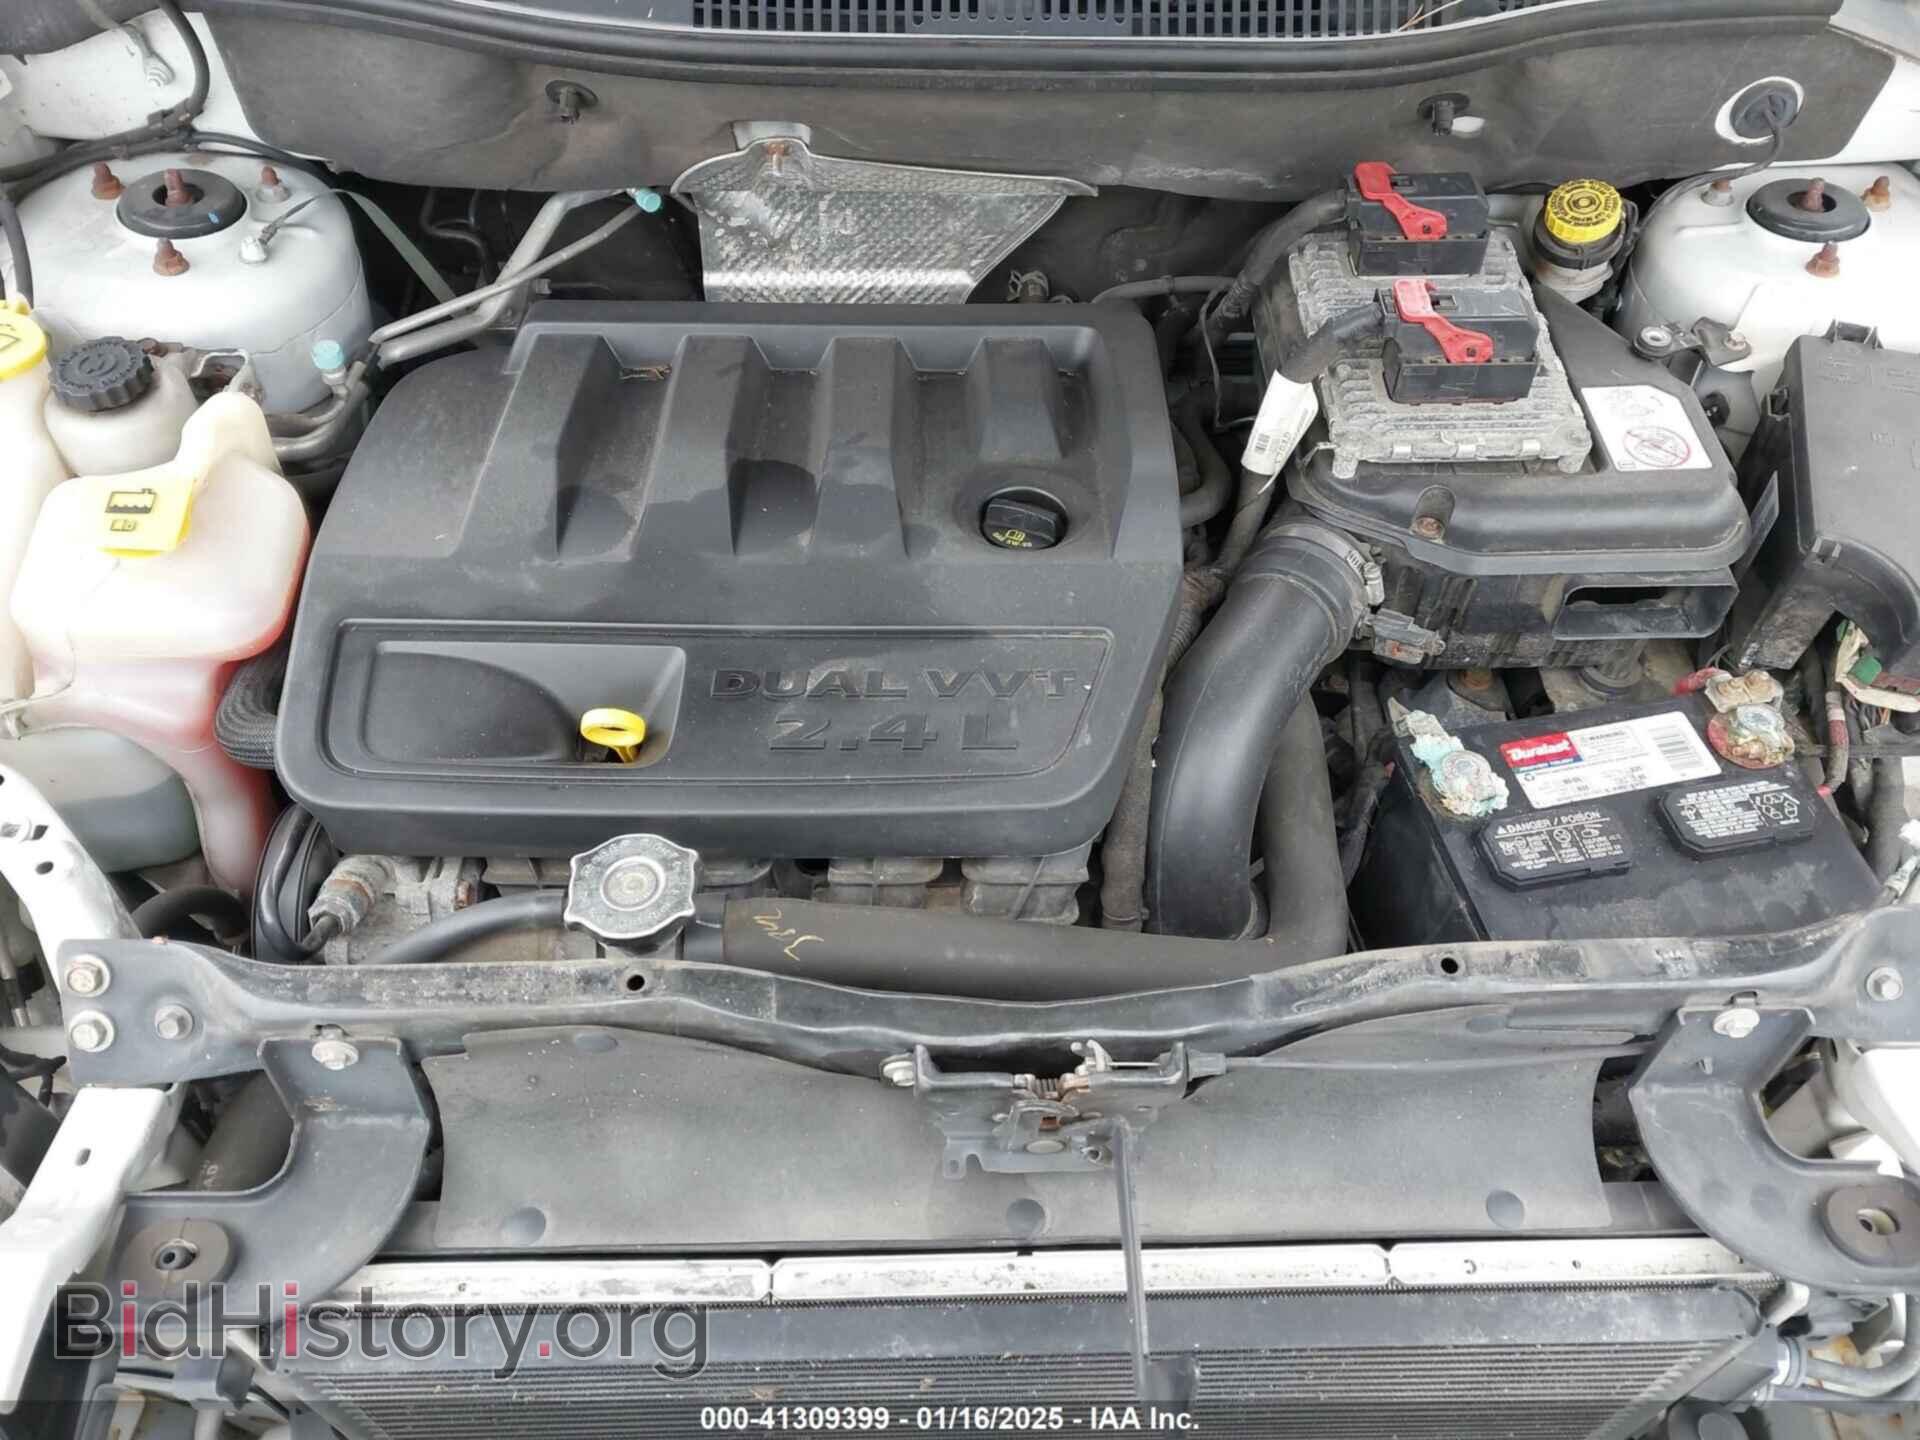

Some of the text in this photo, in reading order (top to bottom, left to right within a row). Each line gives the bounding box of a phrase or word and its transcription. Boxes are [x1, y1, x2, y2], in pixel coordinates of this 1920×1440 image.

[710, 669, 1076, 698] DUAL VVT
[1506, 738, 1573, 763] Duralast
[1506, 818, 1551, 834] DANGER
[1560, 811, 1602, 824] POISON
